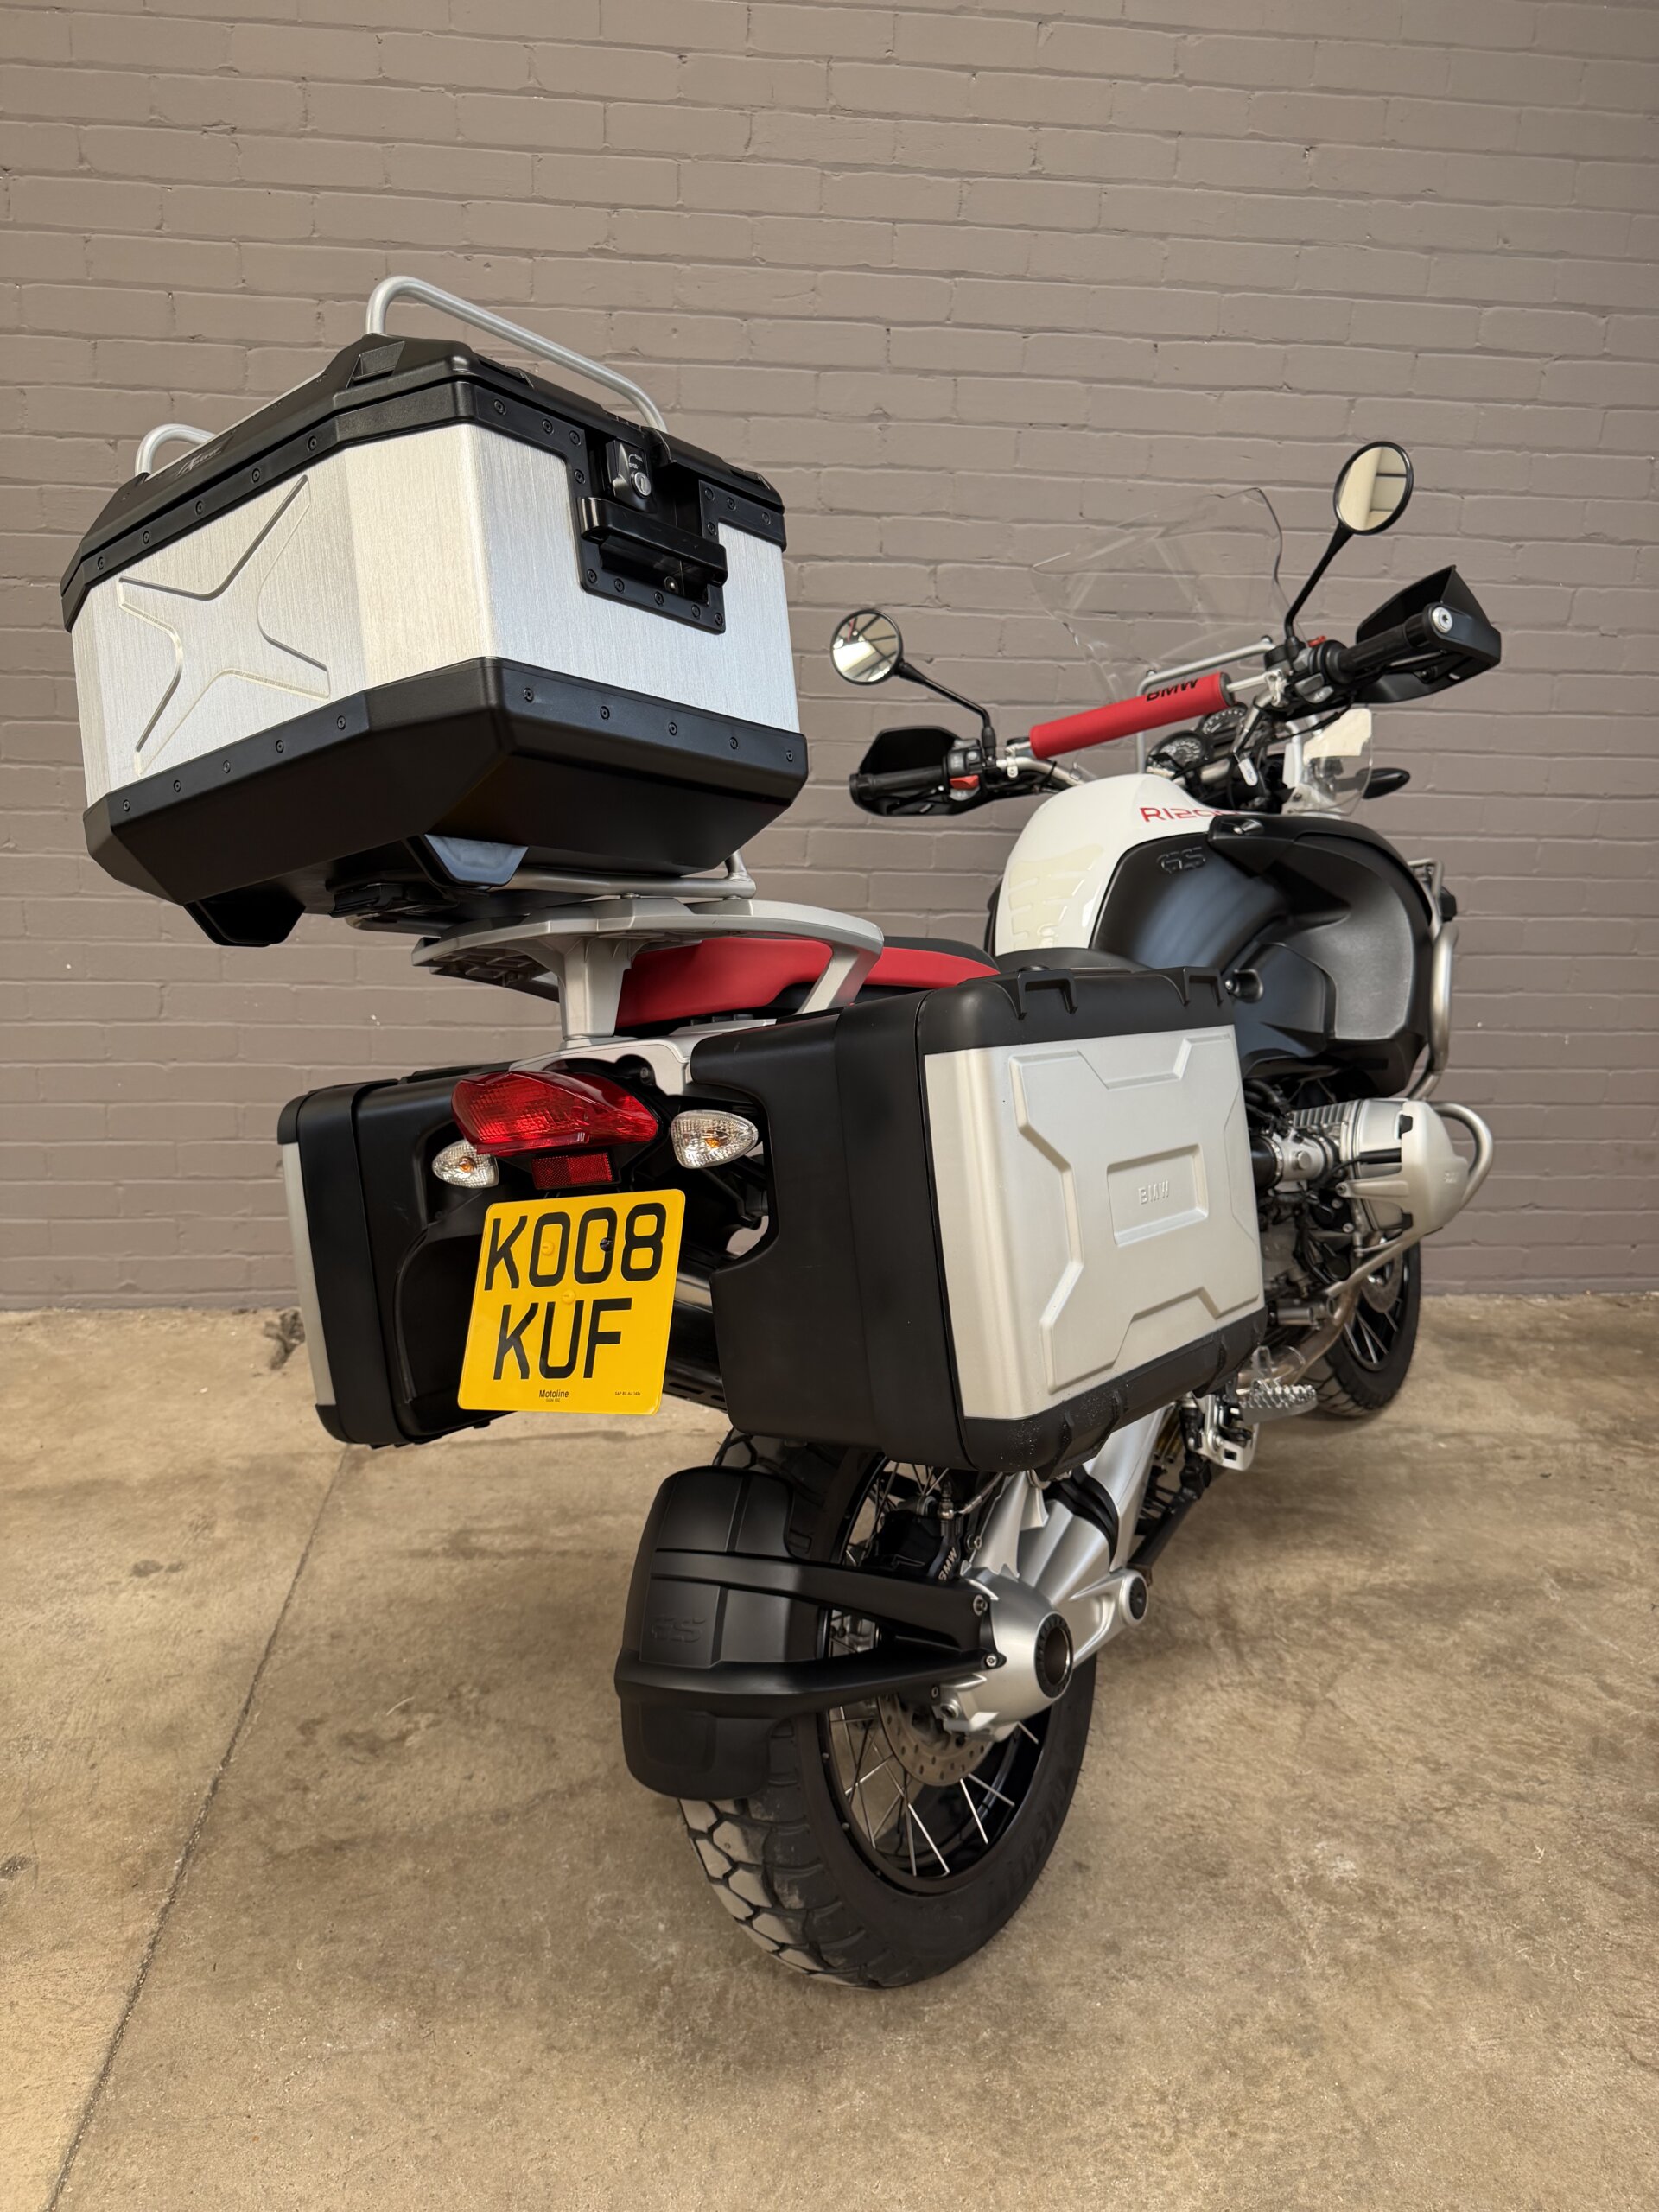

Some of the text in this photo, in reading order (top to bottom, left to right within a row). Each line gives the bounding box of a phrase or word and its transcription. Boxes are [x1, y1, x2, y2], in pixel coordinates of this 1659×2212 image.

[1147, 679, 1199, 702] BMW
[1157, 847, 1207, 874] GS
[1137, 1179, 1169, 1205] BMW
[493, 1297, 632, 1380] KUF
[539, 1389, 569, 1398] Motoline
